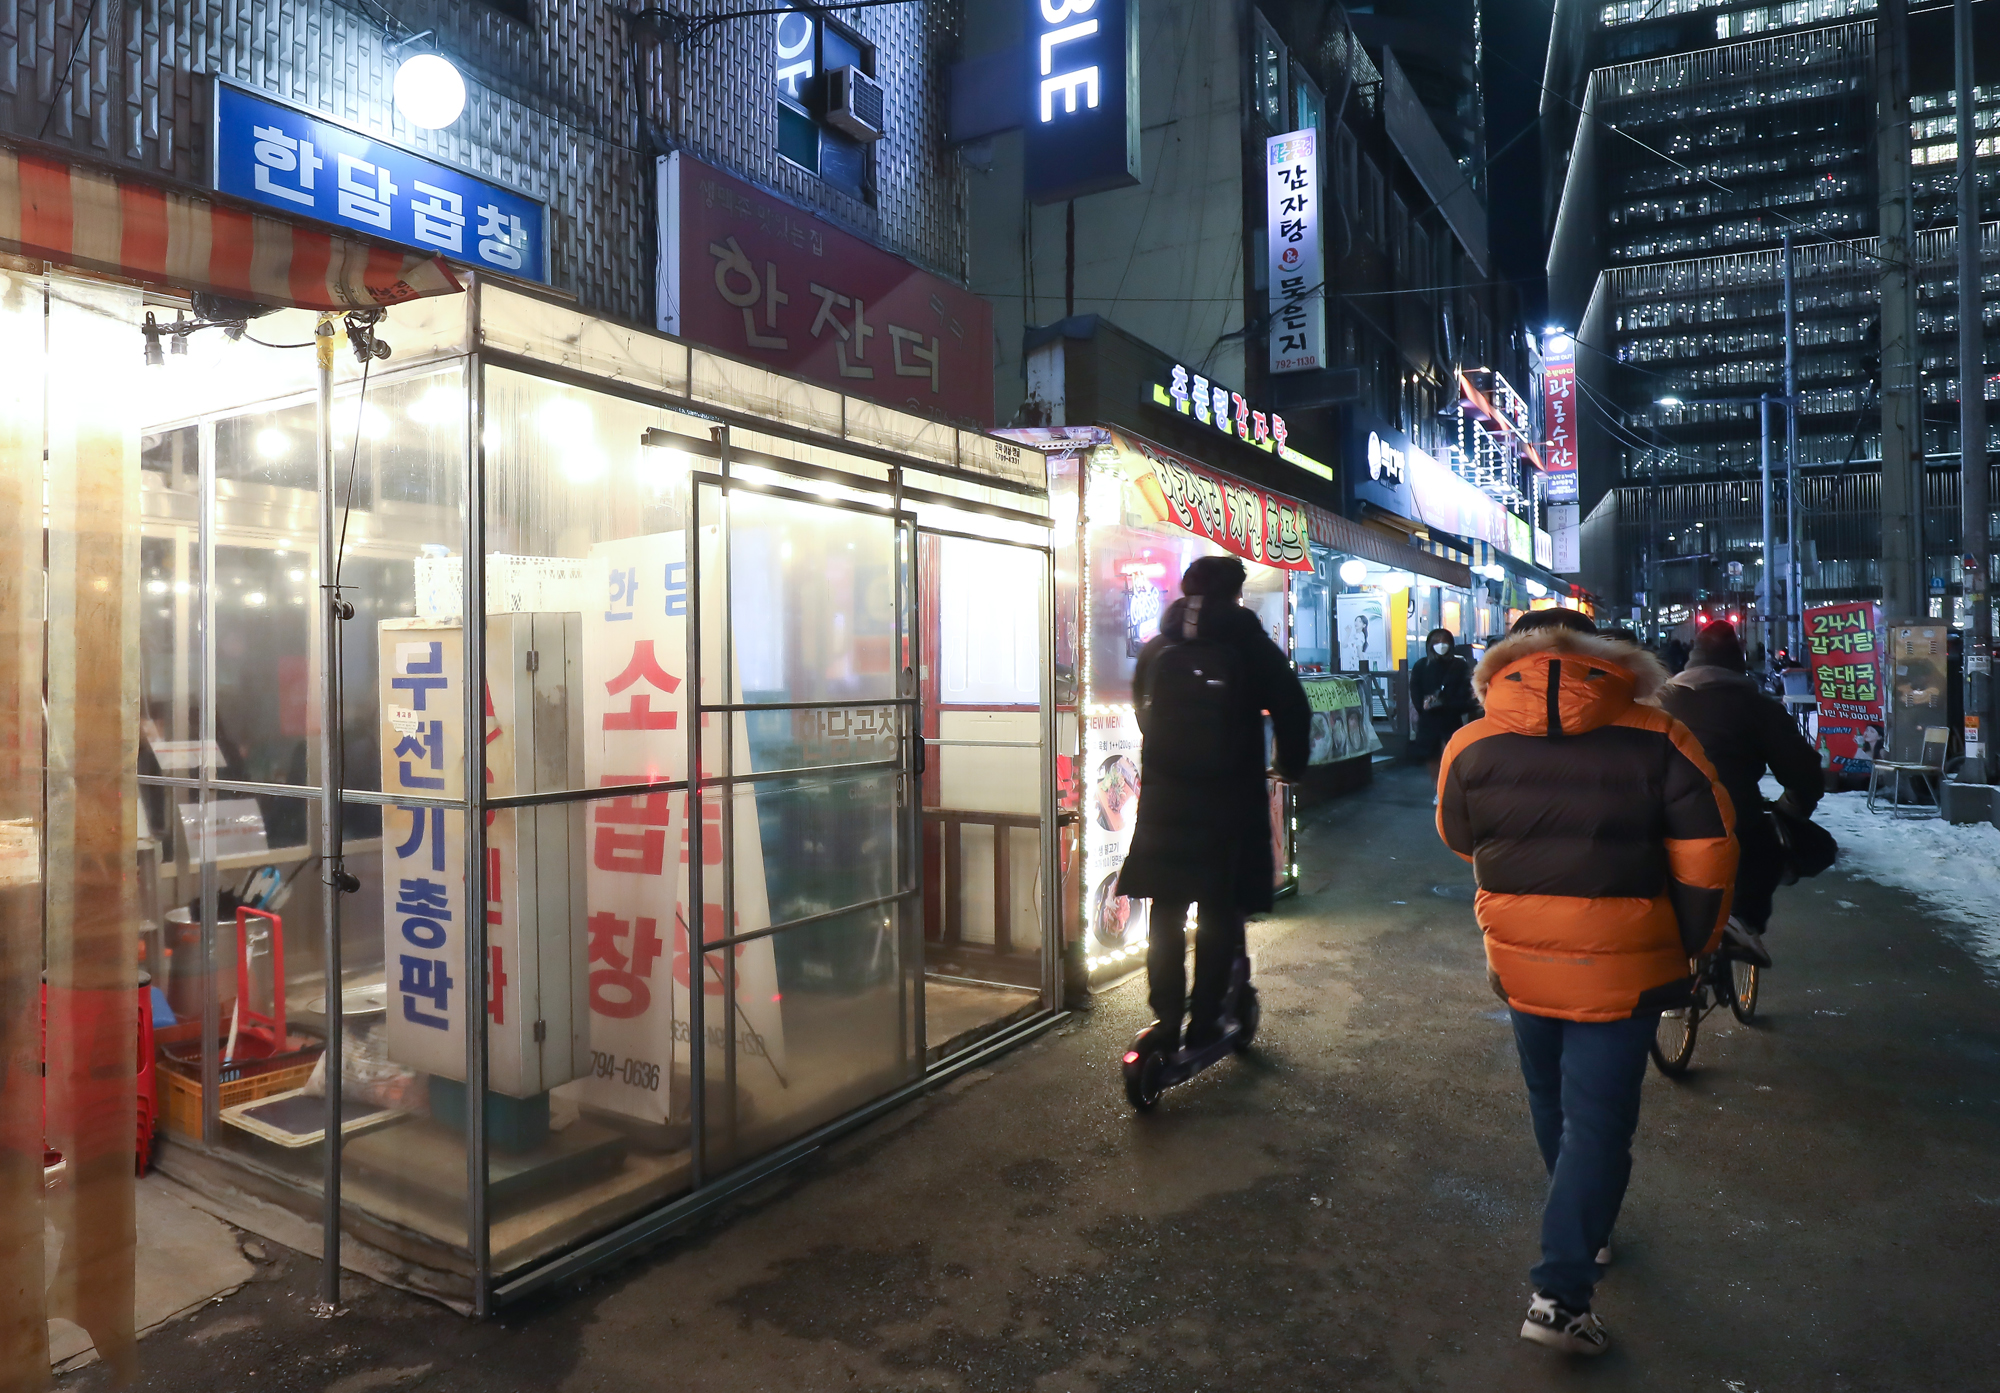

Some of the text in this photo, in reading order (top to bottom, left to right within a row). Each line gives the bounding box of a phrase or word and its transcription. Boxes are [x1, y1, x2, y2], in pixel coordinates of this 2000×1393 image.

[252, 124, 528, 270] 한담곱창
[1277, 165, 1309, 243] 감자탕
[809, 228, 823, 257] 집
[1279, 276, 1308, 354] 묵은지
[1275, 355, 1315, 370] 792-1130
[1561, 353, 1573, 361] OUT
[1265, 493, 1304, 564] 호프
[1813, 610, 1866, 634] 24시
[1808, 633, 1874, 654] 감자탕
[1817, 665, 1874, 682] 순대국
[1820, 683, 1876, 701] 삼겹살
